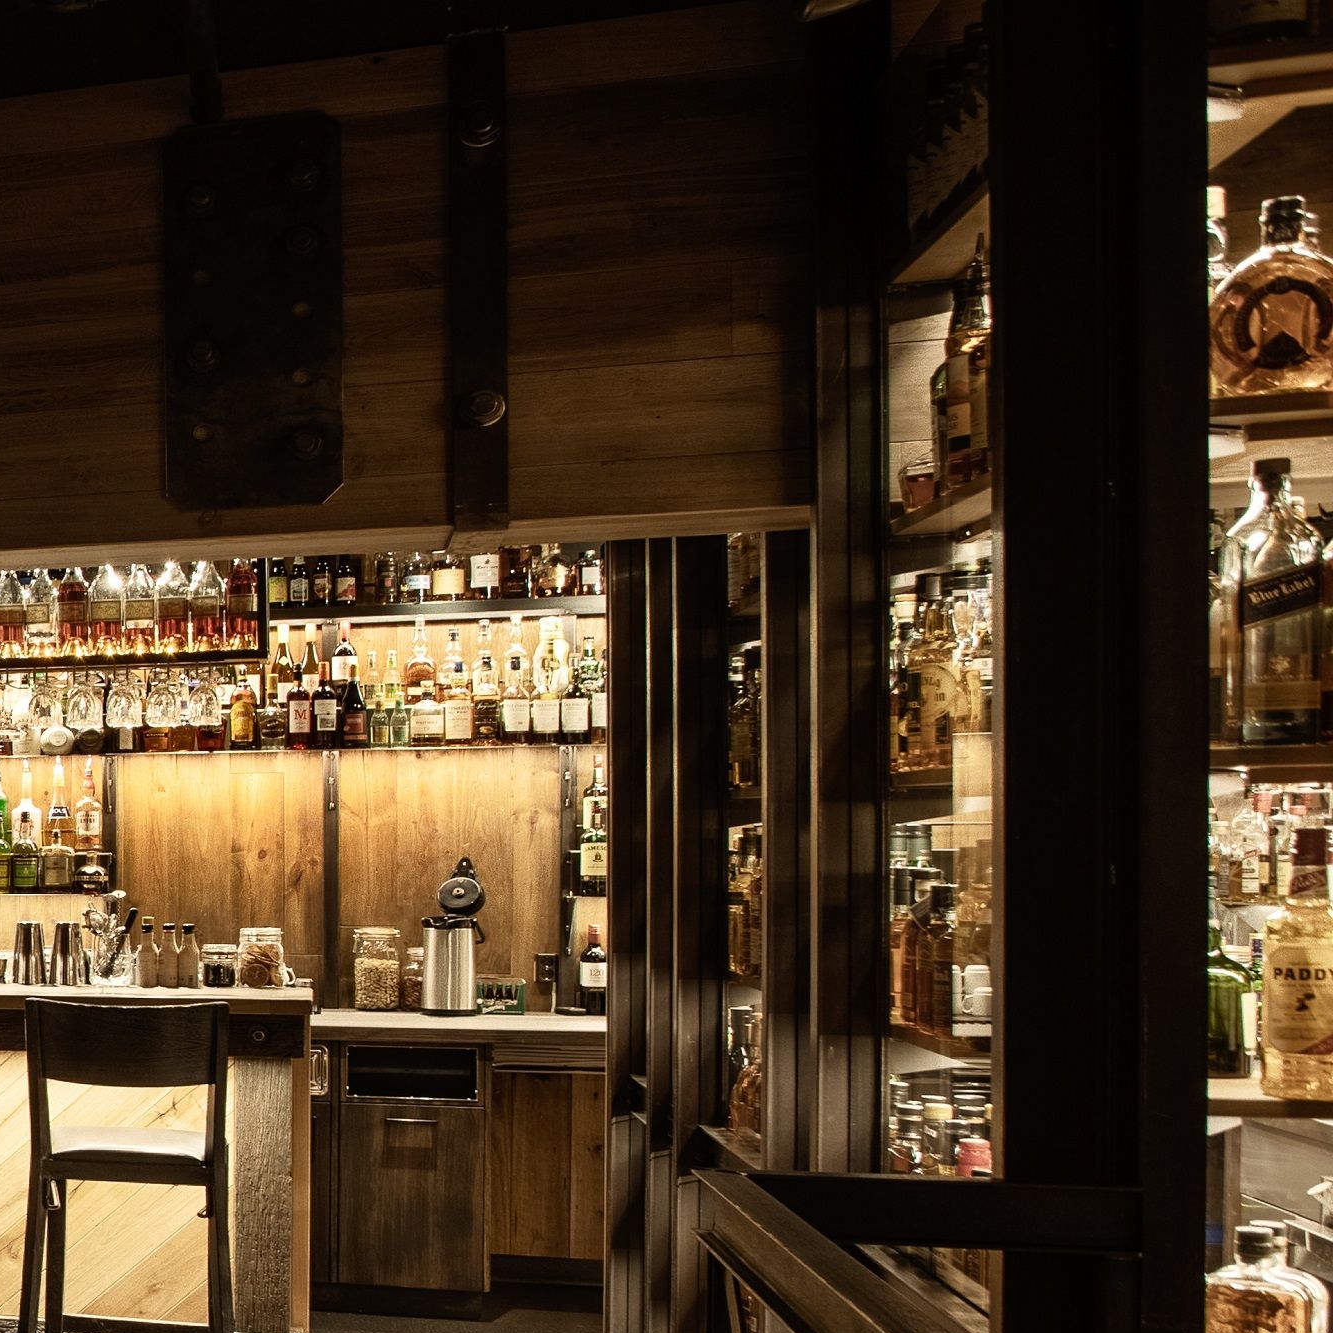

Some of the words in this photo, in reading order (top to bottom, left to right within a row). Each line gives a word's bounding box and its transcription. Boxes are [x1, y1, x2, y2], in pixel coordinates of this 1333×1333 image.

[1247, 586, 1281, 604] Blue
[1281, 575, 1316, 596] Label
[293, 709, 307, 720] M
